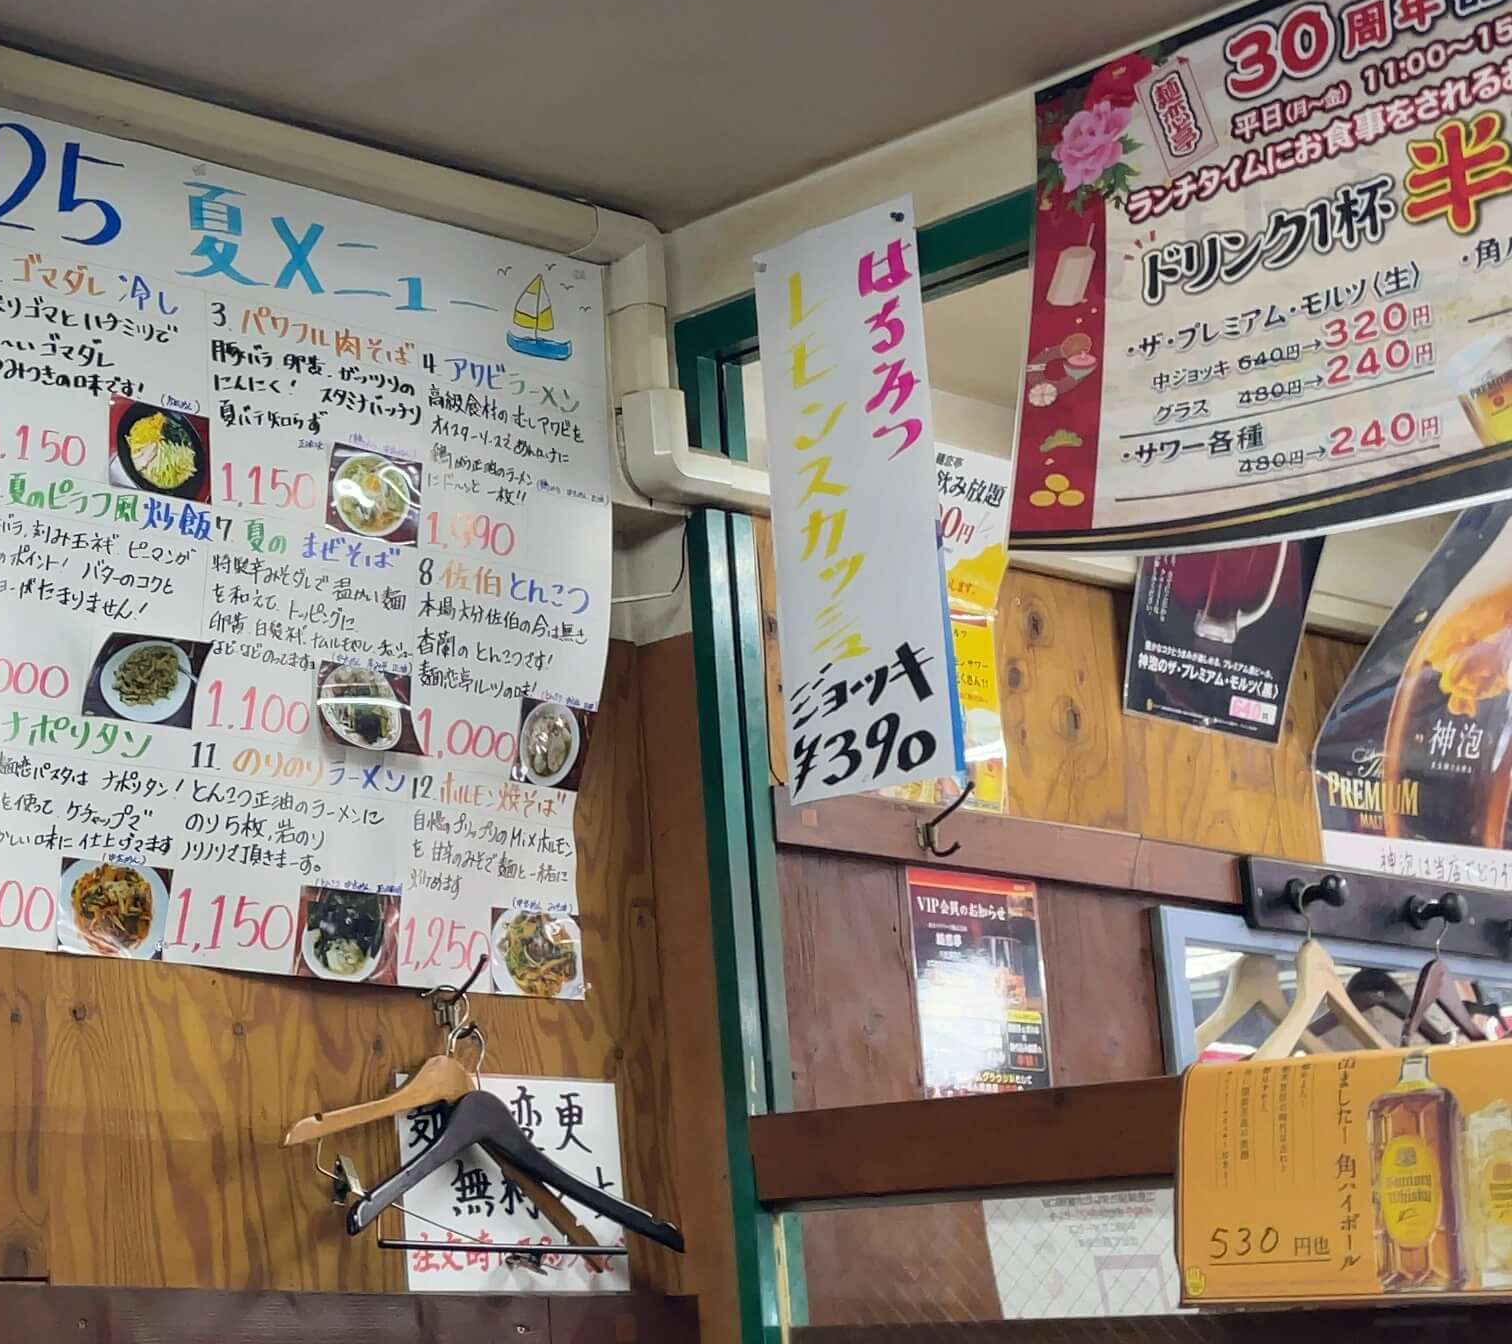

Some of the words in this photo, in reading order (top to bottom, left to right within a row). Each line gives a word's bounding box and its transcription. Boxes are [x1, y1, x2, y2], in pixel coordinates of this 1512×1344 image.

[174, 180, 498, 312] 夏メニュー
[1144, 174, 1394, 304] ドリンク1杯
[240, 306, 416, 366] パワフル肉そば
[857, 238, 922, 462] はちみつ
[1152, 359, 1231, 392] 中ジョッキ
[1323, 301, 1433, 350] 320円
[444, 357, 580, 414] アワビラーメン
[1156, 398, 1210, 424] グラス
[1325, 339, 1435, 388] 240円
[219, 399, 329, 435] 夏バテ知らず
[1329, 413, 1440, 459] 240円
[786, 270, 872, 664] レモンスカッシュ
[7, 471, 213, 542] 夏のピラフ風炒飯
[80, 558, 175, 596] バターのコクと
[441, 559, 591, 617] 佐伯とんこつ
[791, 640, 934, 730] ジョッキ
[2, 711, 153, 758] ナポリタン
[792, 711, 937, 800] ¥390
[1429, 718, 1485, 760] 神泡
[231, 747, 406, 793] のりのりラーメン
[439, 771, 568, 818] ホルモン焼そば
[1327, 770, 1420, 817] PREMIUM
[1209, 1226, 1280, 1259] 530
[1336, 1153, 1361, 1273] 角ハイボール
